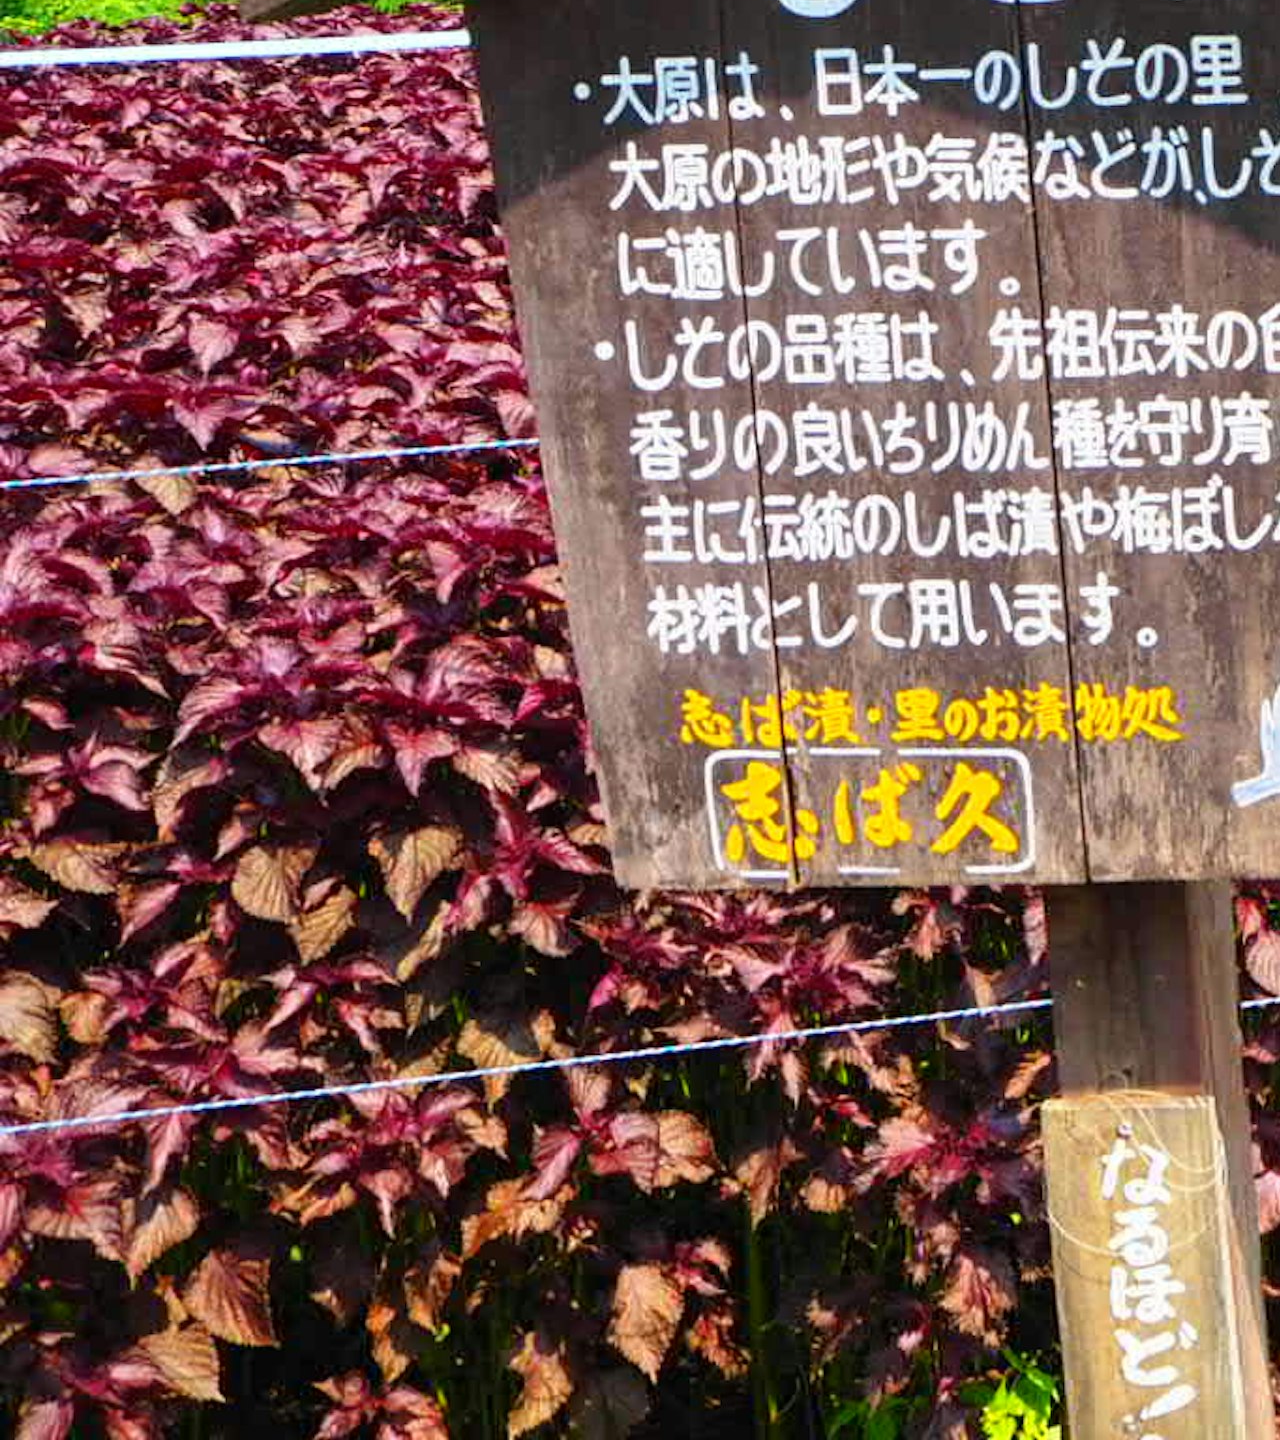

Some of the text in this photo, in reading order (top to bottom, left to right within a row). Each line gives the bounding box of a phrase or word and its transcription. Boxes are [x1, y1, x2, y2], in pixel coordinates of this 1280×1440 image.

[617, 219, 1021, 300] に適しています。
[647, 572, 1158, 654] 材料として用います。
[680, 682, 1183, 747] 志ば漬・里のお漬物処
[720, 761, 1019, 863] 志ば久
